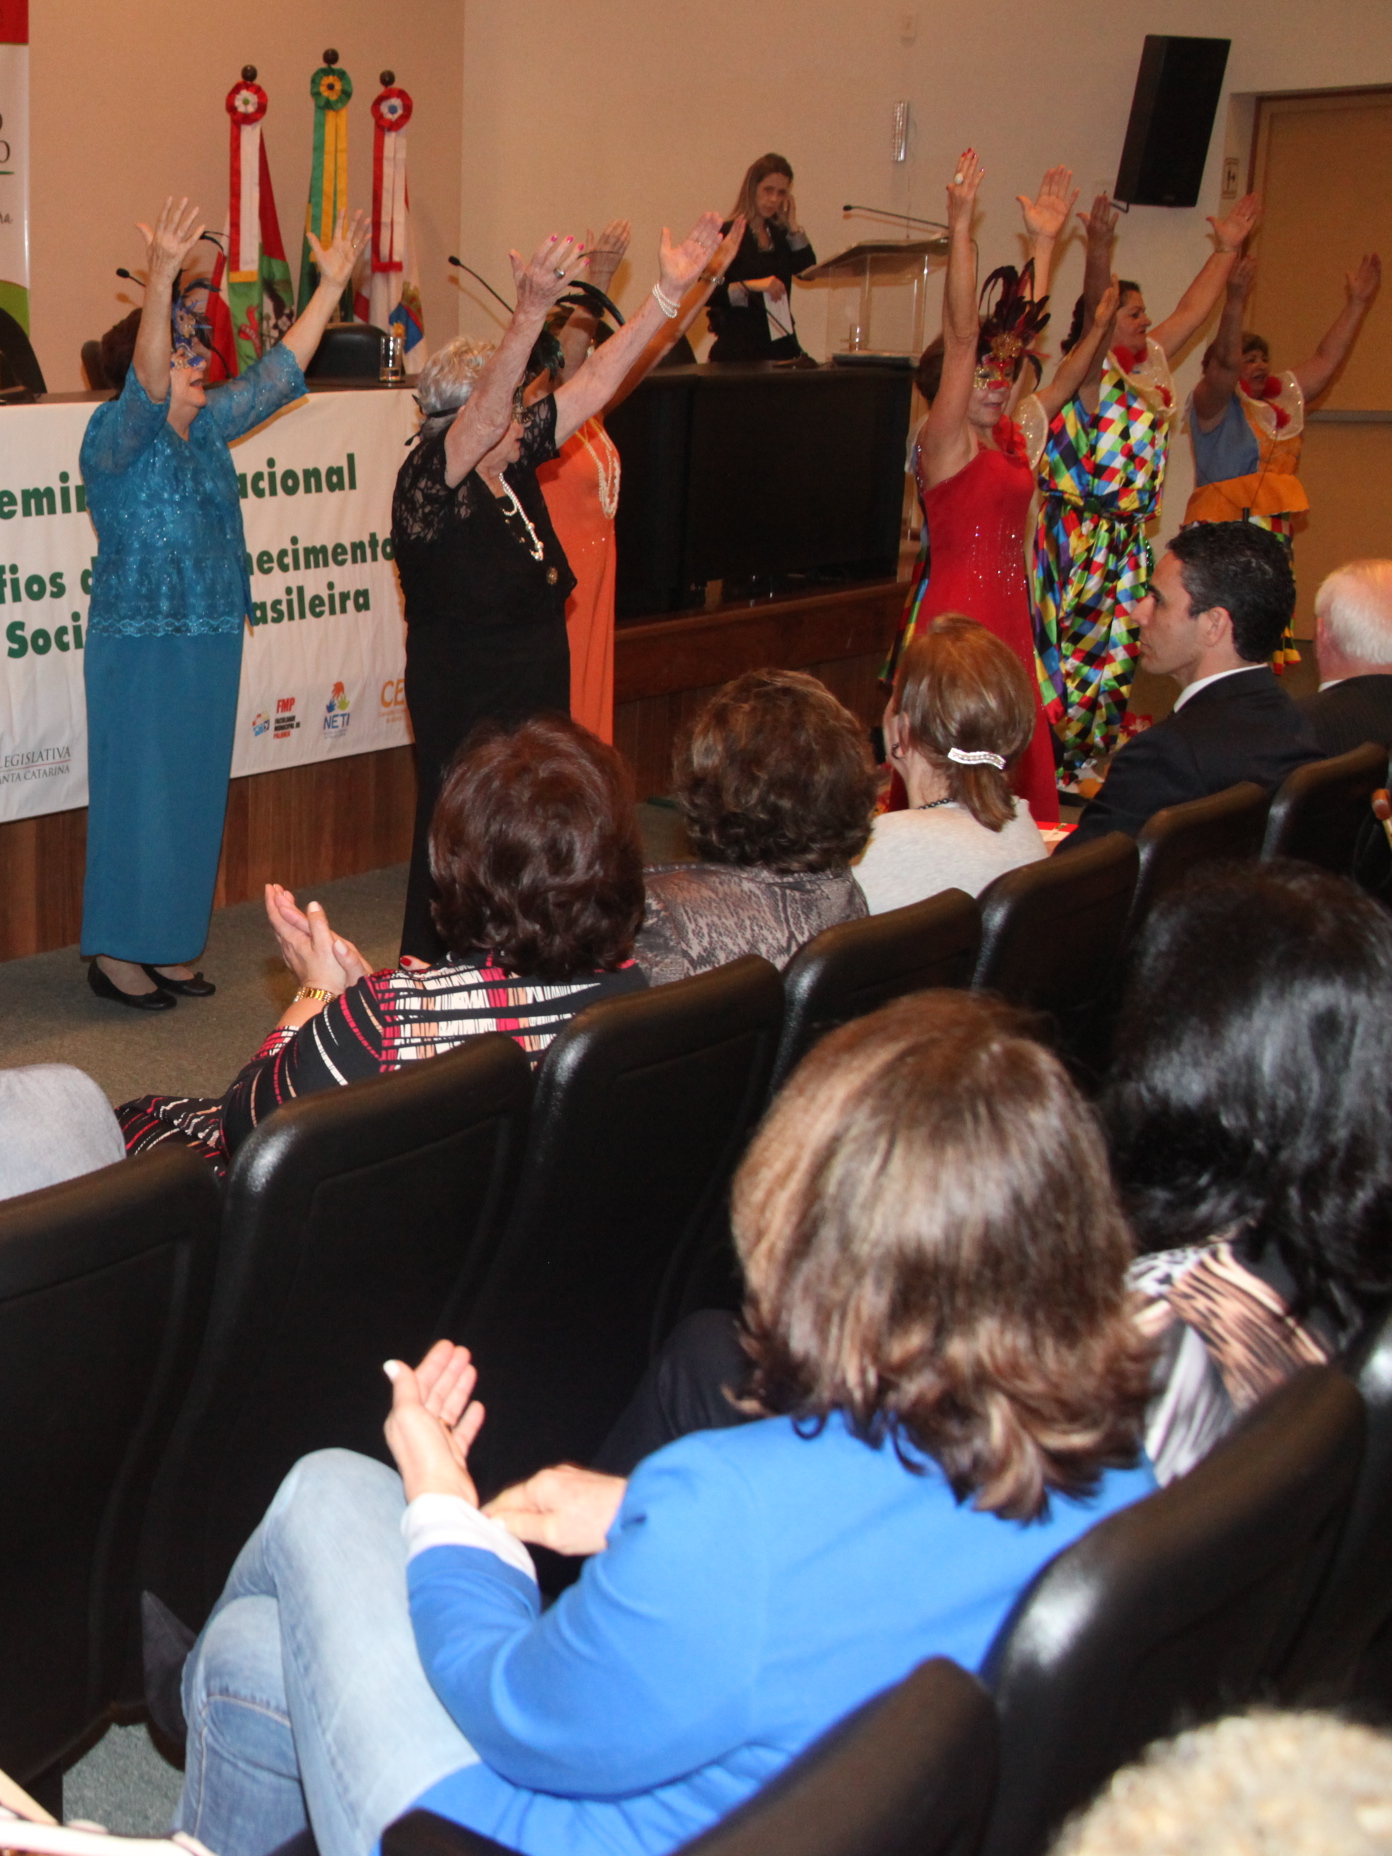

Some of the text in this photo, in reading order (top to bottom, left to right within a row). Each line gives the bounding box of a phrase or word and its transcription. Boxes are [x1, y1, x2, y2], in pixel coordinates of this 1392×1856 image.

[236, 453, 357, 499] acional
[253, 581, 371, 627] asileira
[276, 697, 295, 713] FMP
[323, 713, 350, 729] NETI
[23, 764, 71, 781] CATARINA
